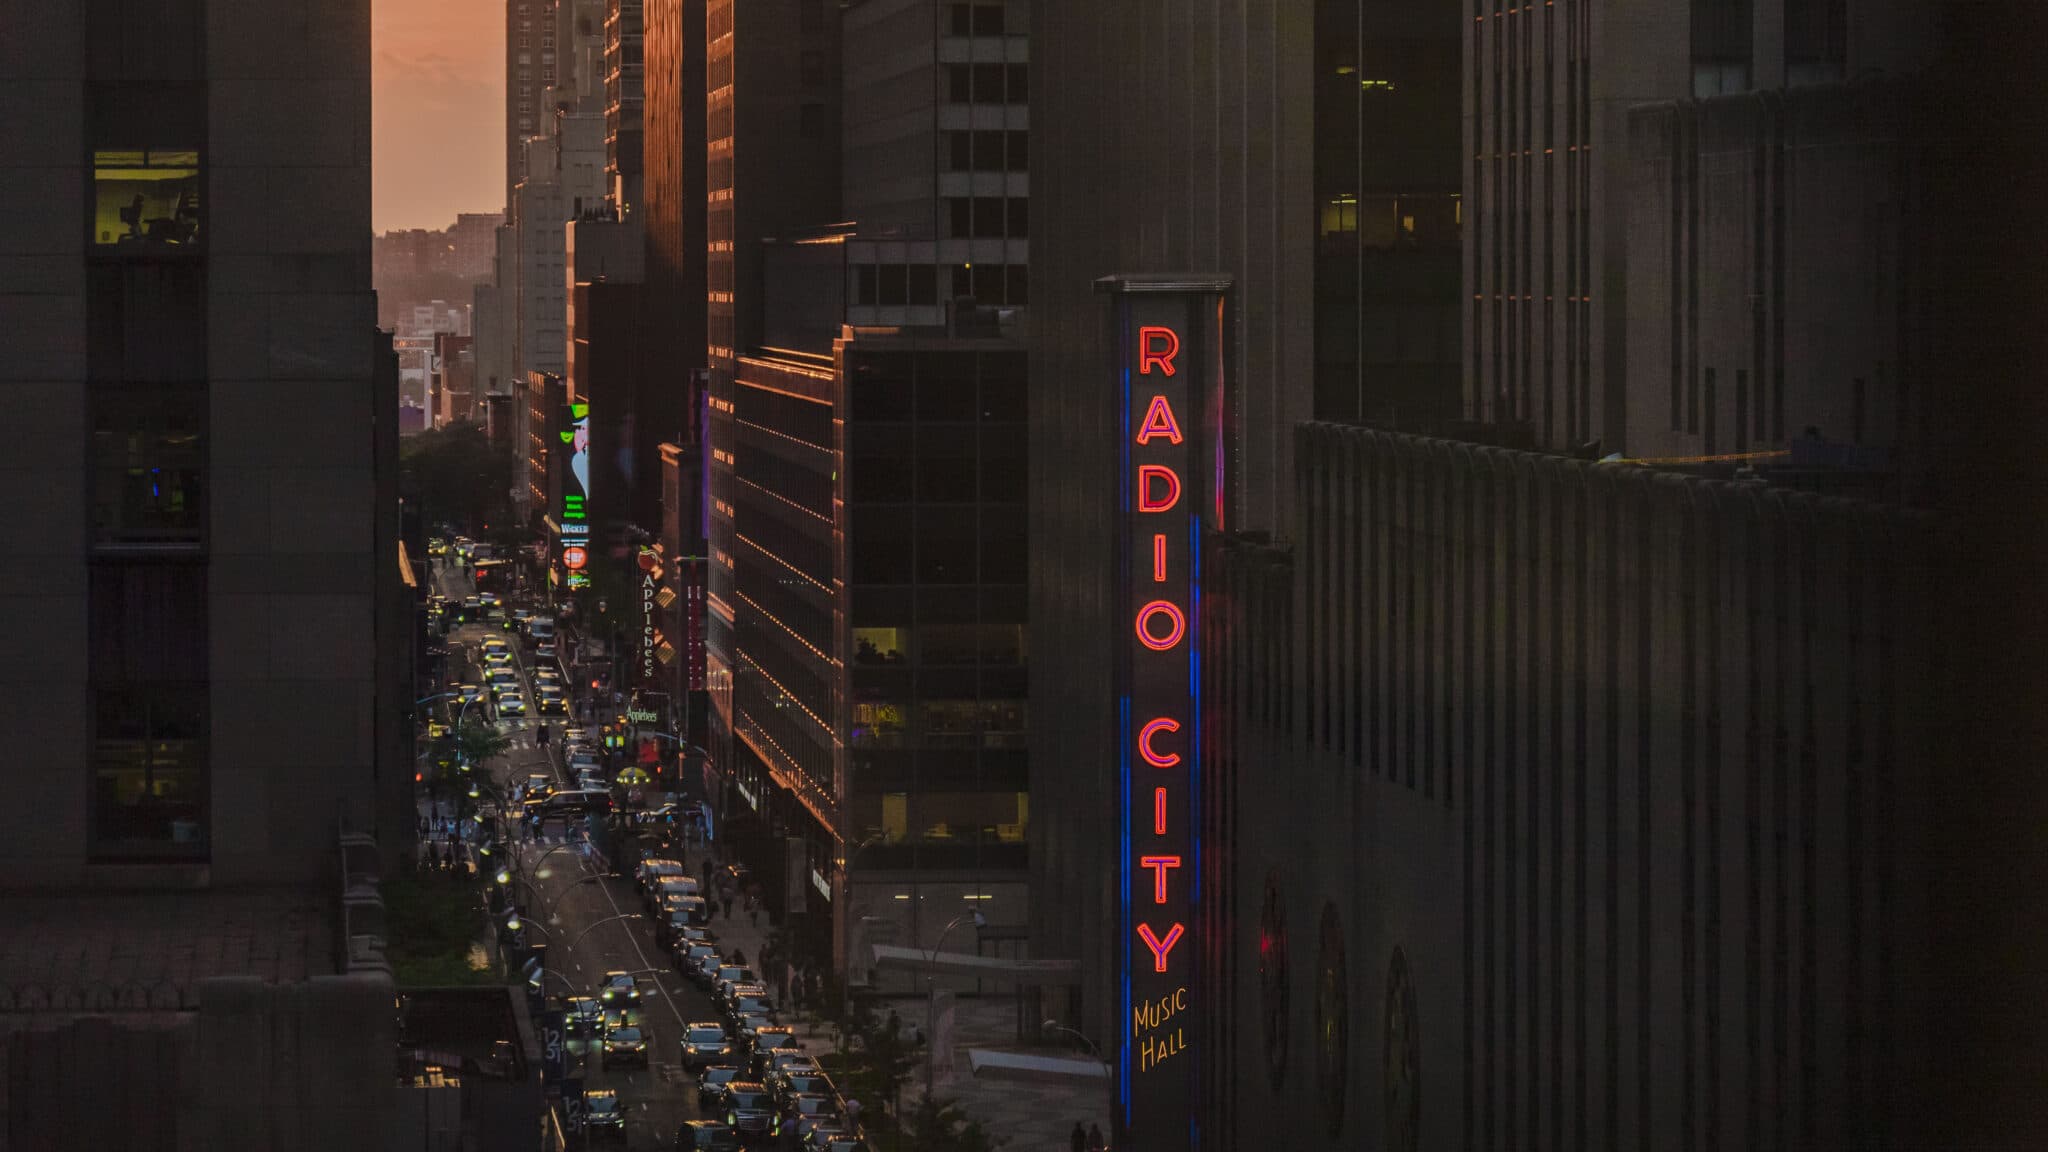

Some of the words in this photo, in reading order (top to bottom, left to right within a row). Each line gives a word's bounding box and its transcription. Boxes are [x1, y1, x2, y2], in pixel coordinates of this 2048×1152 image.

[1136, 326, 1185, 651] RADIO
[1136, 717, 1185, 973] CITY
[542, 1027, 561, 1047] 12
[1134, 987, 1186, 1037] MUSIC
[1141, 1028, 1187, 1073] HALL
